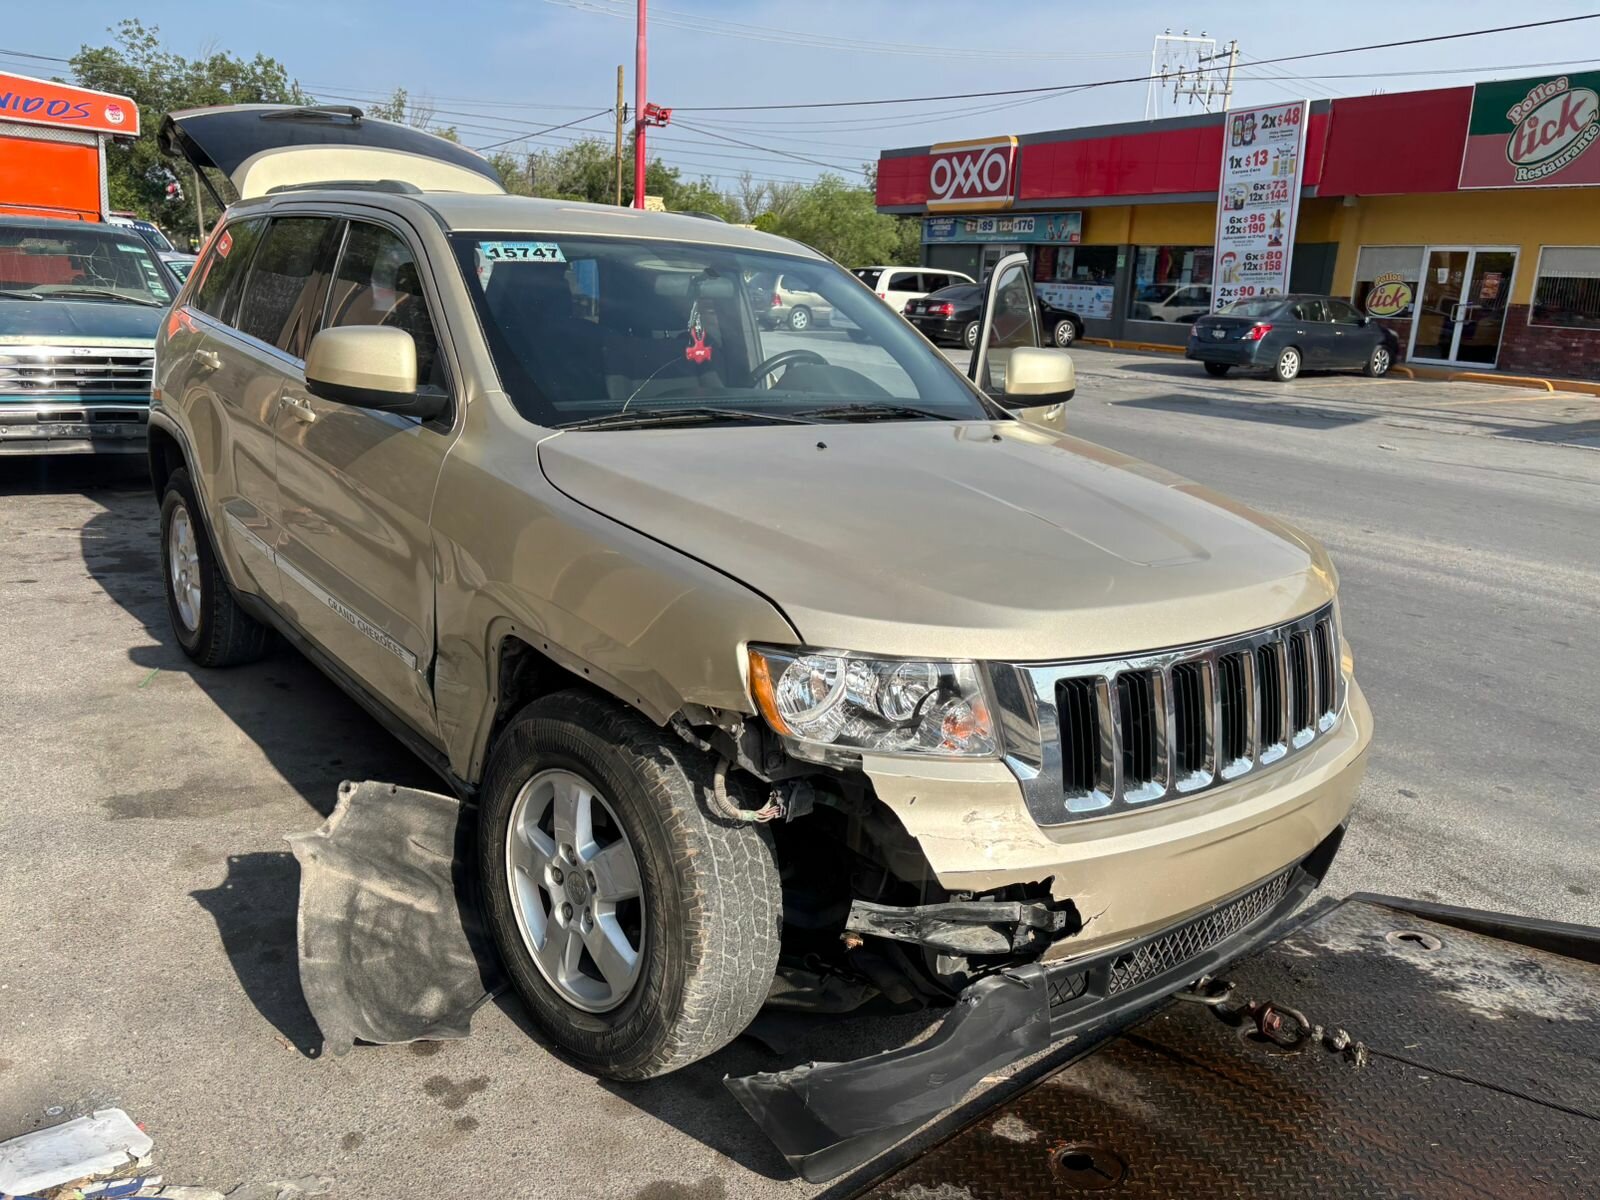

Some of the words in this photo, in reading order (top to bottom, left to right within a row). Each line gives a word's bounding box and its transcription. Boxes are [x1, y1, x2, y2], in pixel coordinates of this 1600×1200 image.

[1508, 77, 1567, 123] Pollos
[930, 149, 1006, 200] OXXO
[1245, 149, 1269, 167] $13
[1516, 125, 1599, 181] Restaurante
[489, 247, 558, 259] 15747
[328, 597, 355, 625] GRAND
[357, 620, 404, 657] CHEROKEE
